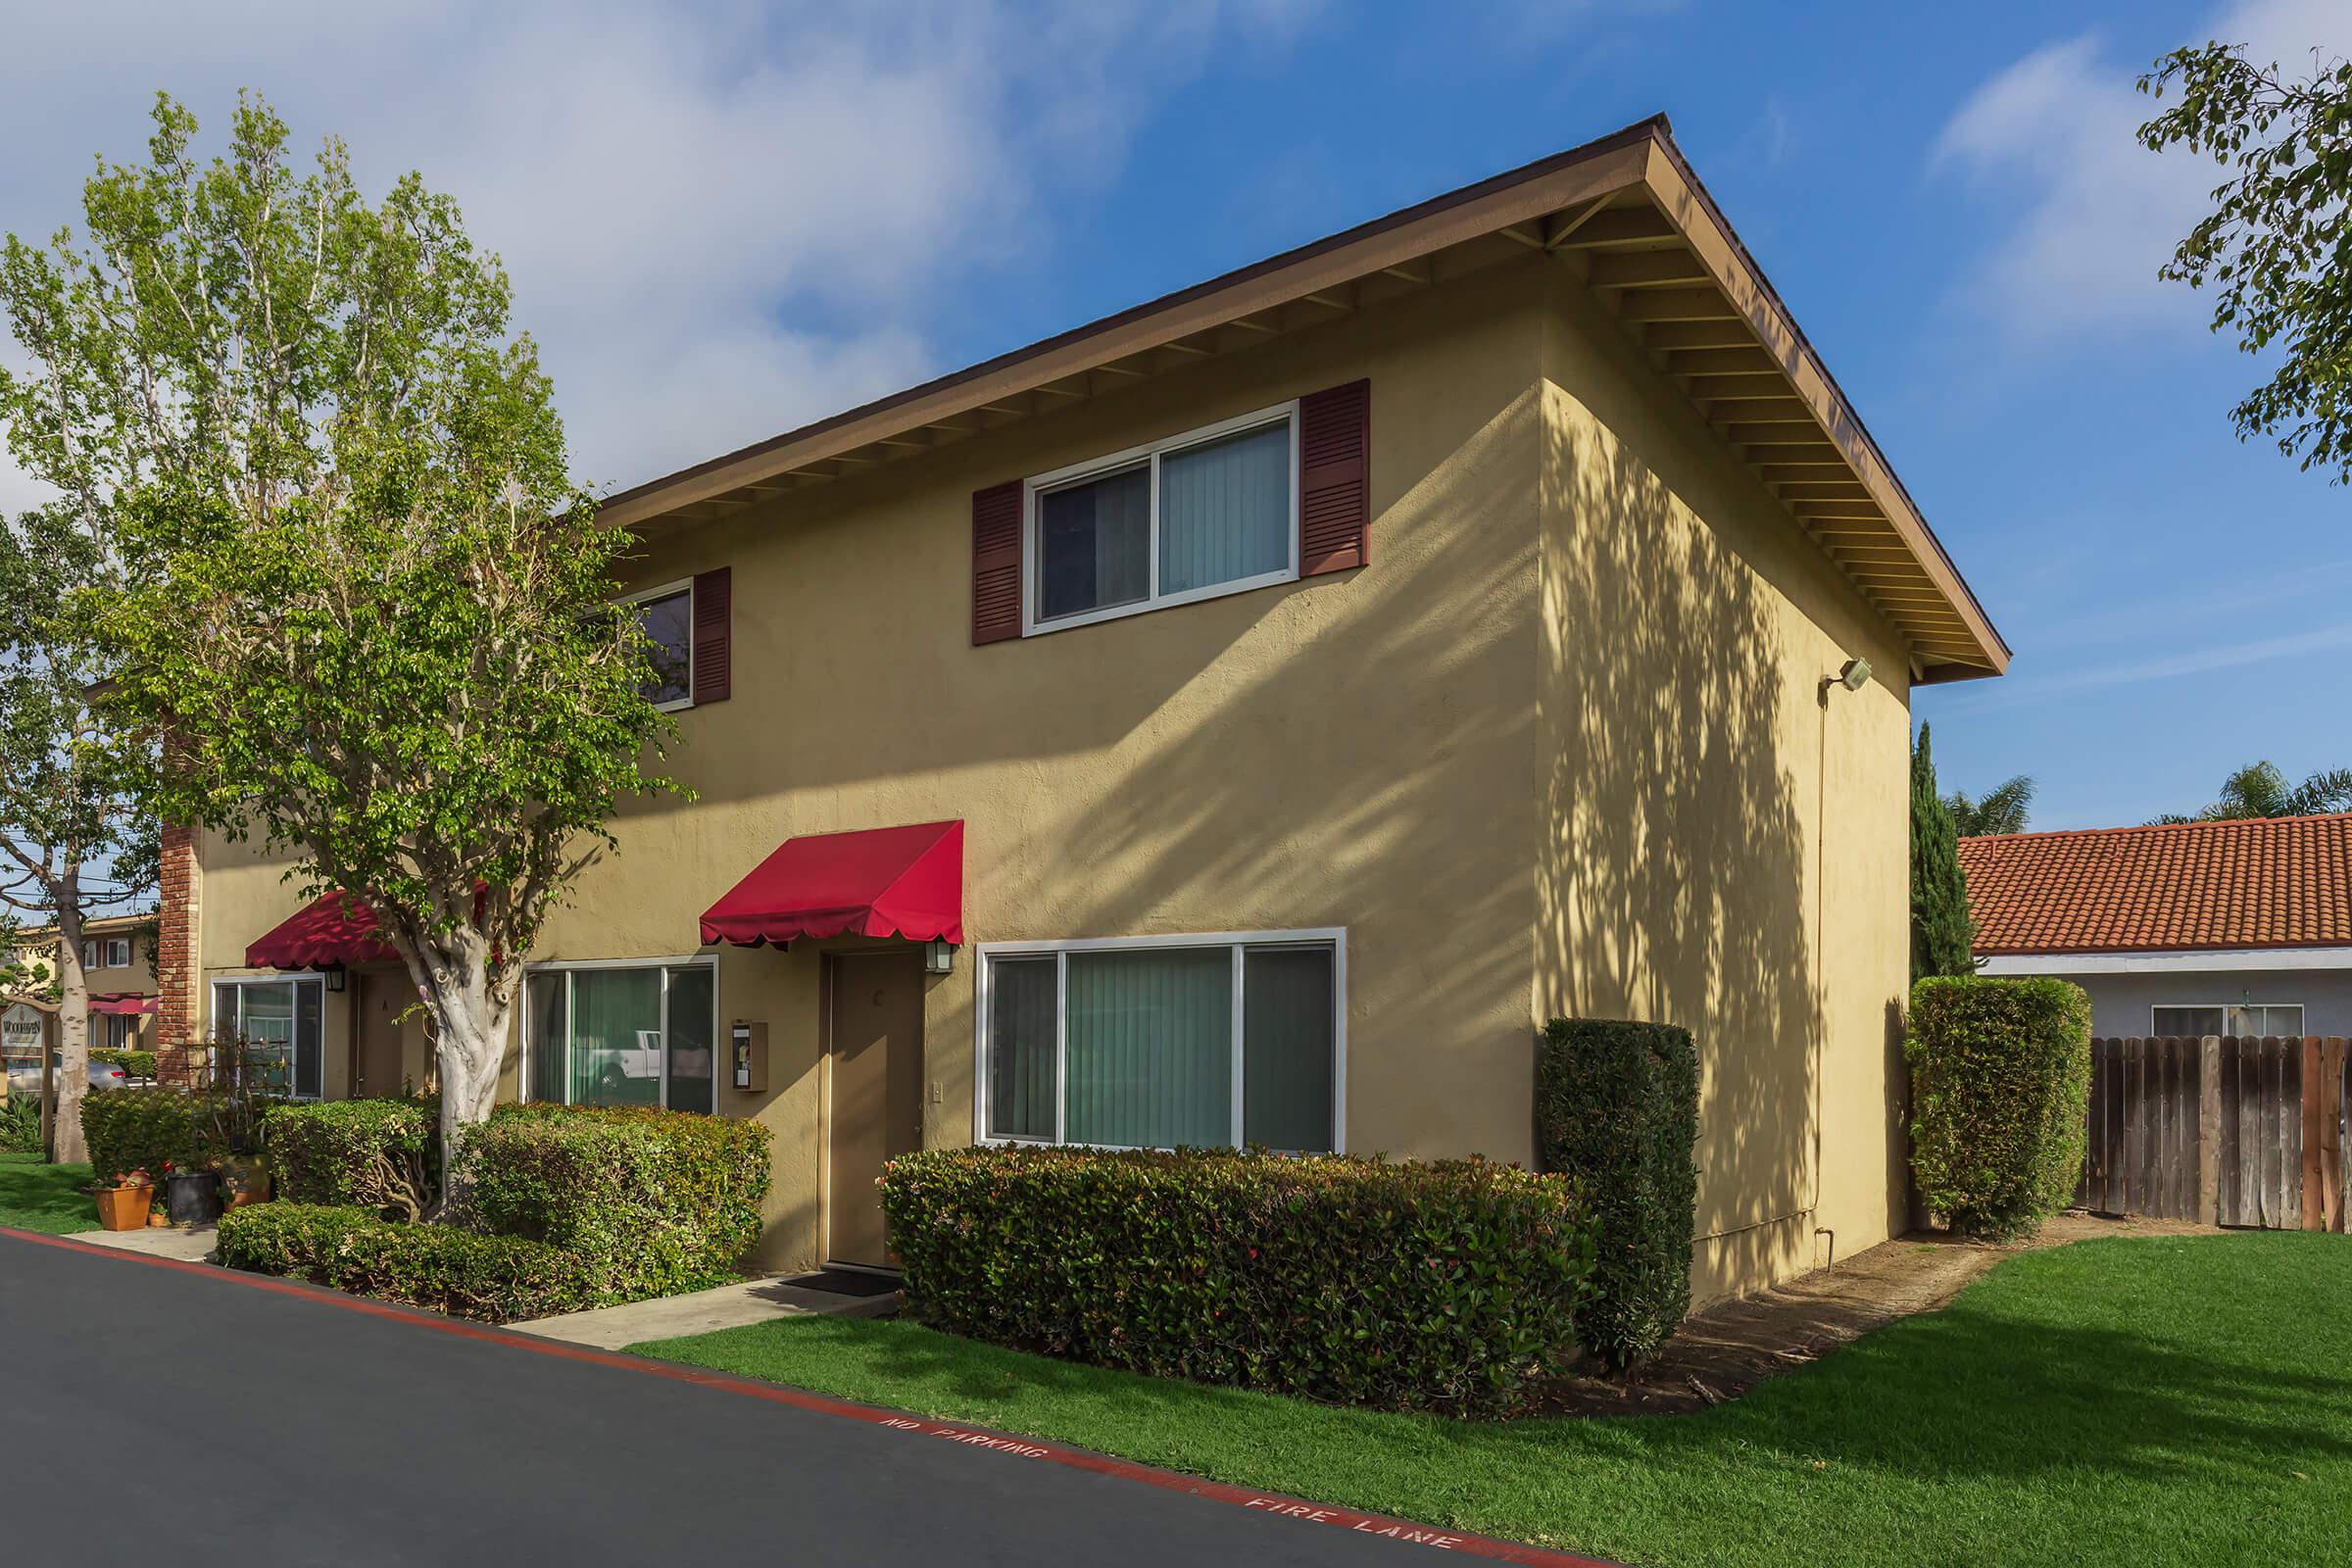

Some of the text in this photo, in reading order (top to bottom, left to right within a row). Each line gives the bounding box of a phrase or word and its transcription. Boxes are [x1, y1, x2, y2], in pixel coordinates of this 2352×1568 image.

[878, 1418, 1049, 1458] NO PARKING
[1245, 1497, 1463, 1549] FIRE LANE
